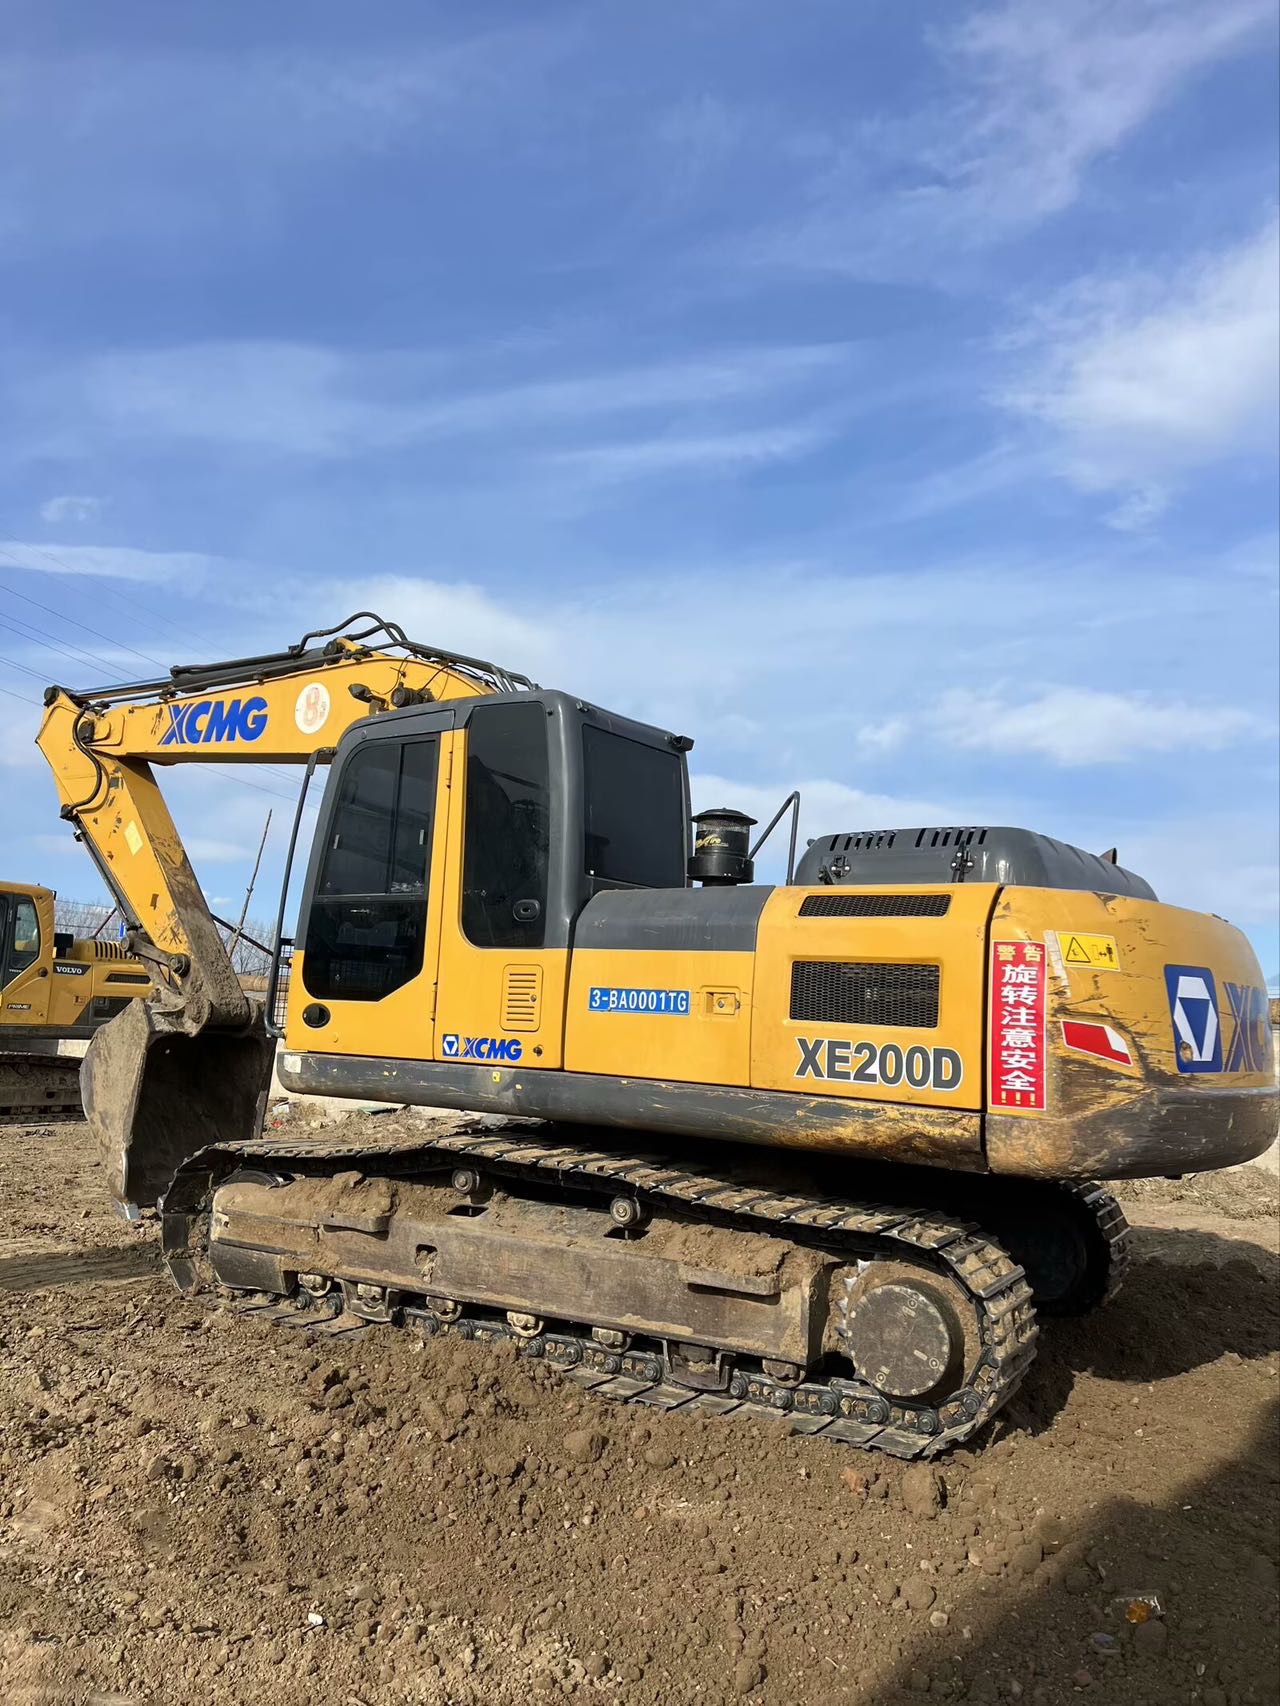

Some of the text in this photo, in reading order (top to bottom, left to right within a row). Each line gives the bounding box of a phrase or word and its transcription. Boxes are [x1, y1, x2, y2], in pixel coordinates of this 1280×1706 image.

[157, 696, 269, 745] XCMG
[996, 944, 1043, 962] 警告
[55, 965, 82, 975] VOLVO
[591, 989, 687, 1011] 3-BA0001TG
[1000, 963, 1039, 1092] 旋转注意安全
[460, 1037, 523, 1061] XCMG
[794, 1037, 963, 1091] XE200D
